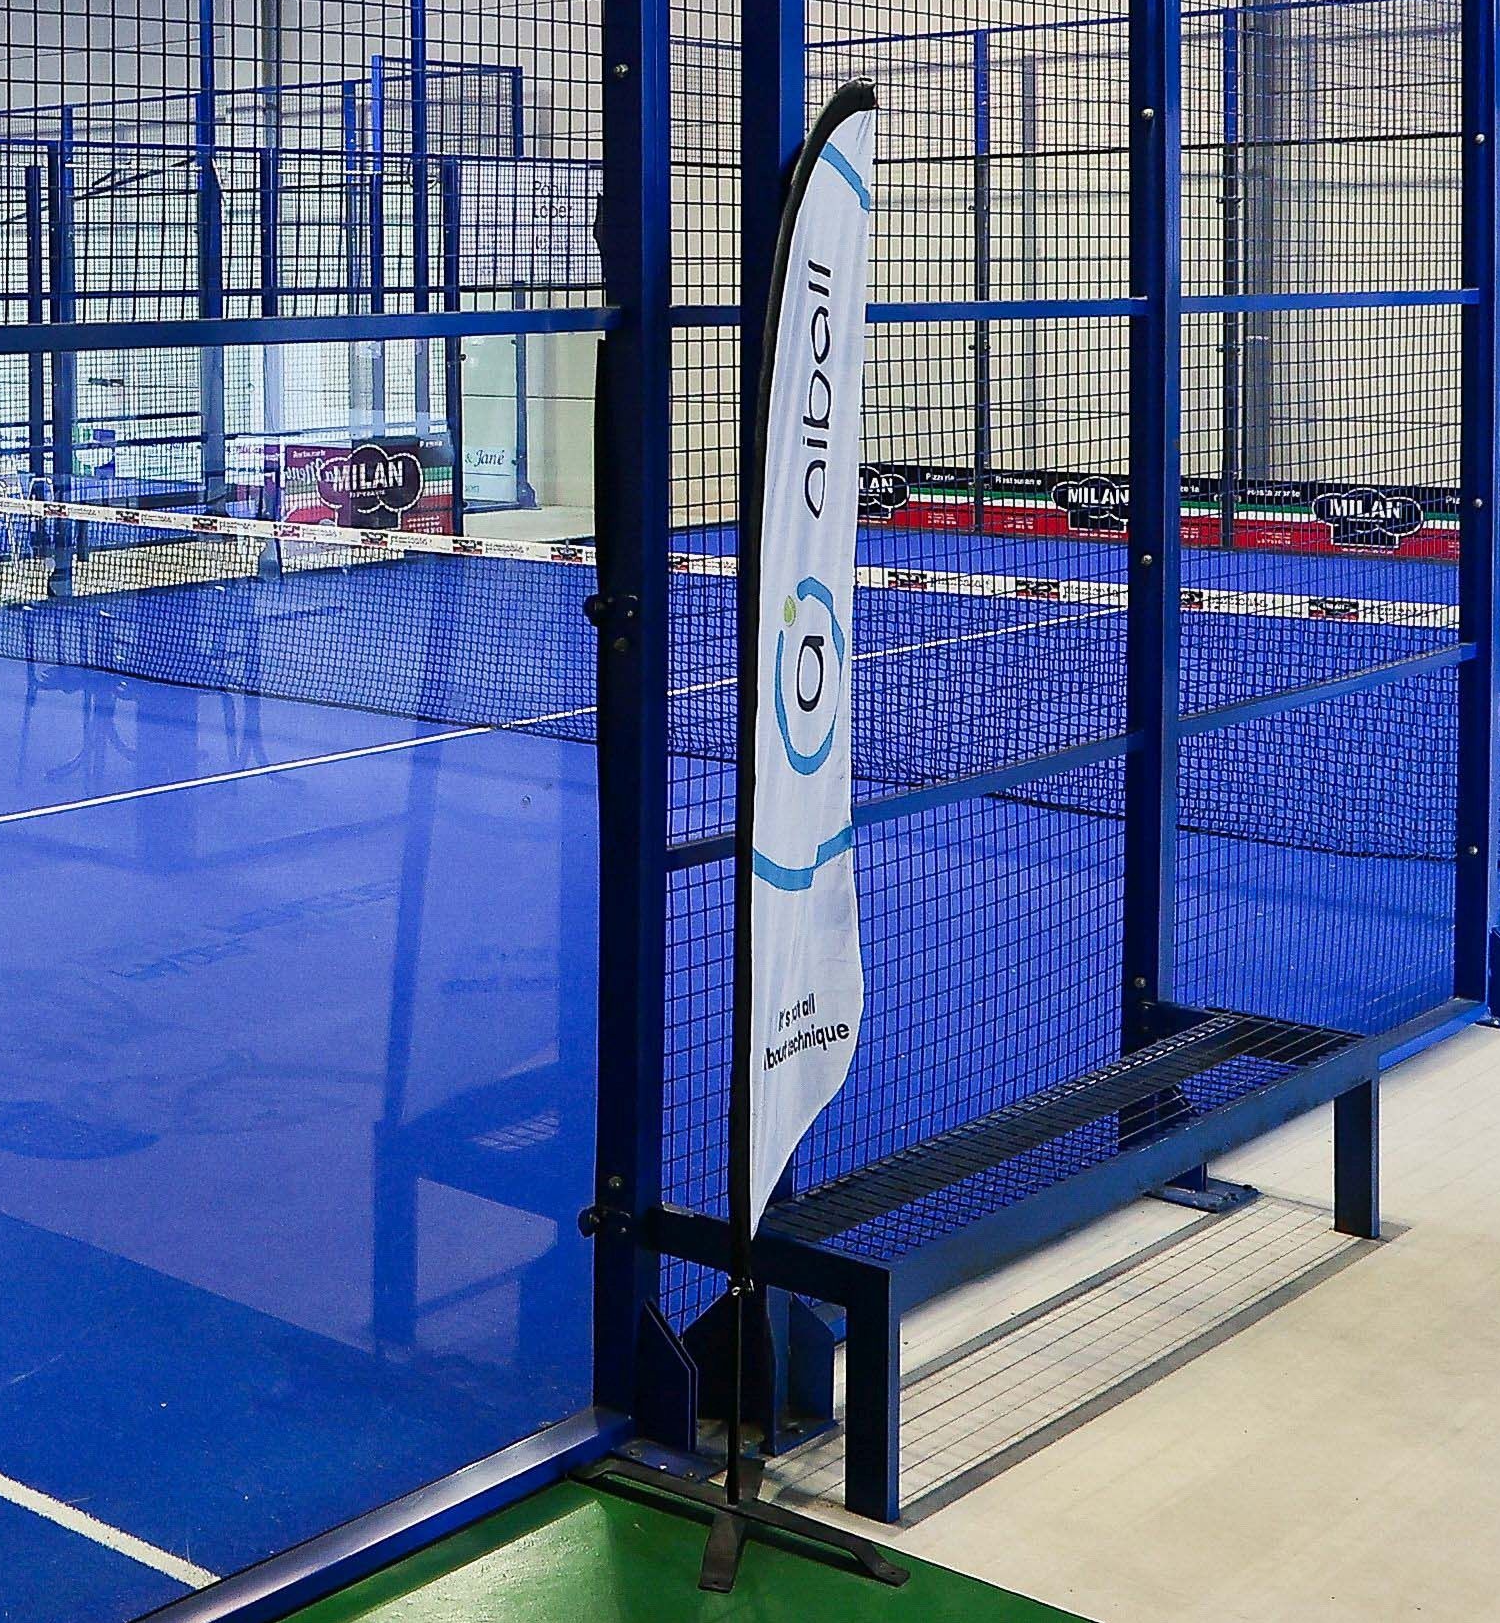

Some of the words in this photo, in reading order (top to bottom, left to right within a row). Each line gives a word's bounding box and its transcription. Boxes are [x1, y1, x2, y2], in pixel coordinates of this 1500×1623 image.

[801, 258, 833, 520] aiball
[331, 459, 404, 493] MILAN
[859, 476, 893, 494] LAN
[1067, 487, 1129, 505] MILAN
[1329, 498, 1403, 519] MILAN
[802, 992, 816, 1017] all
